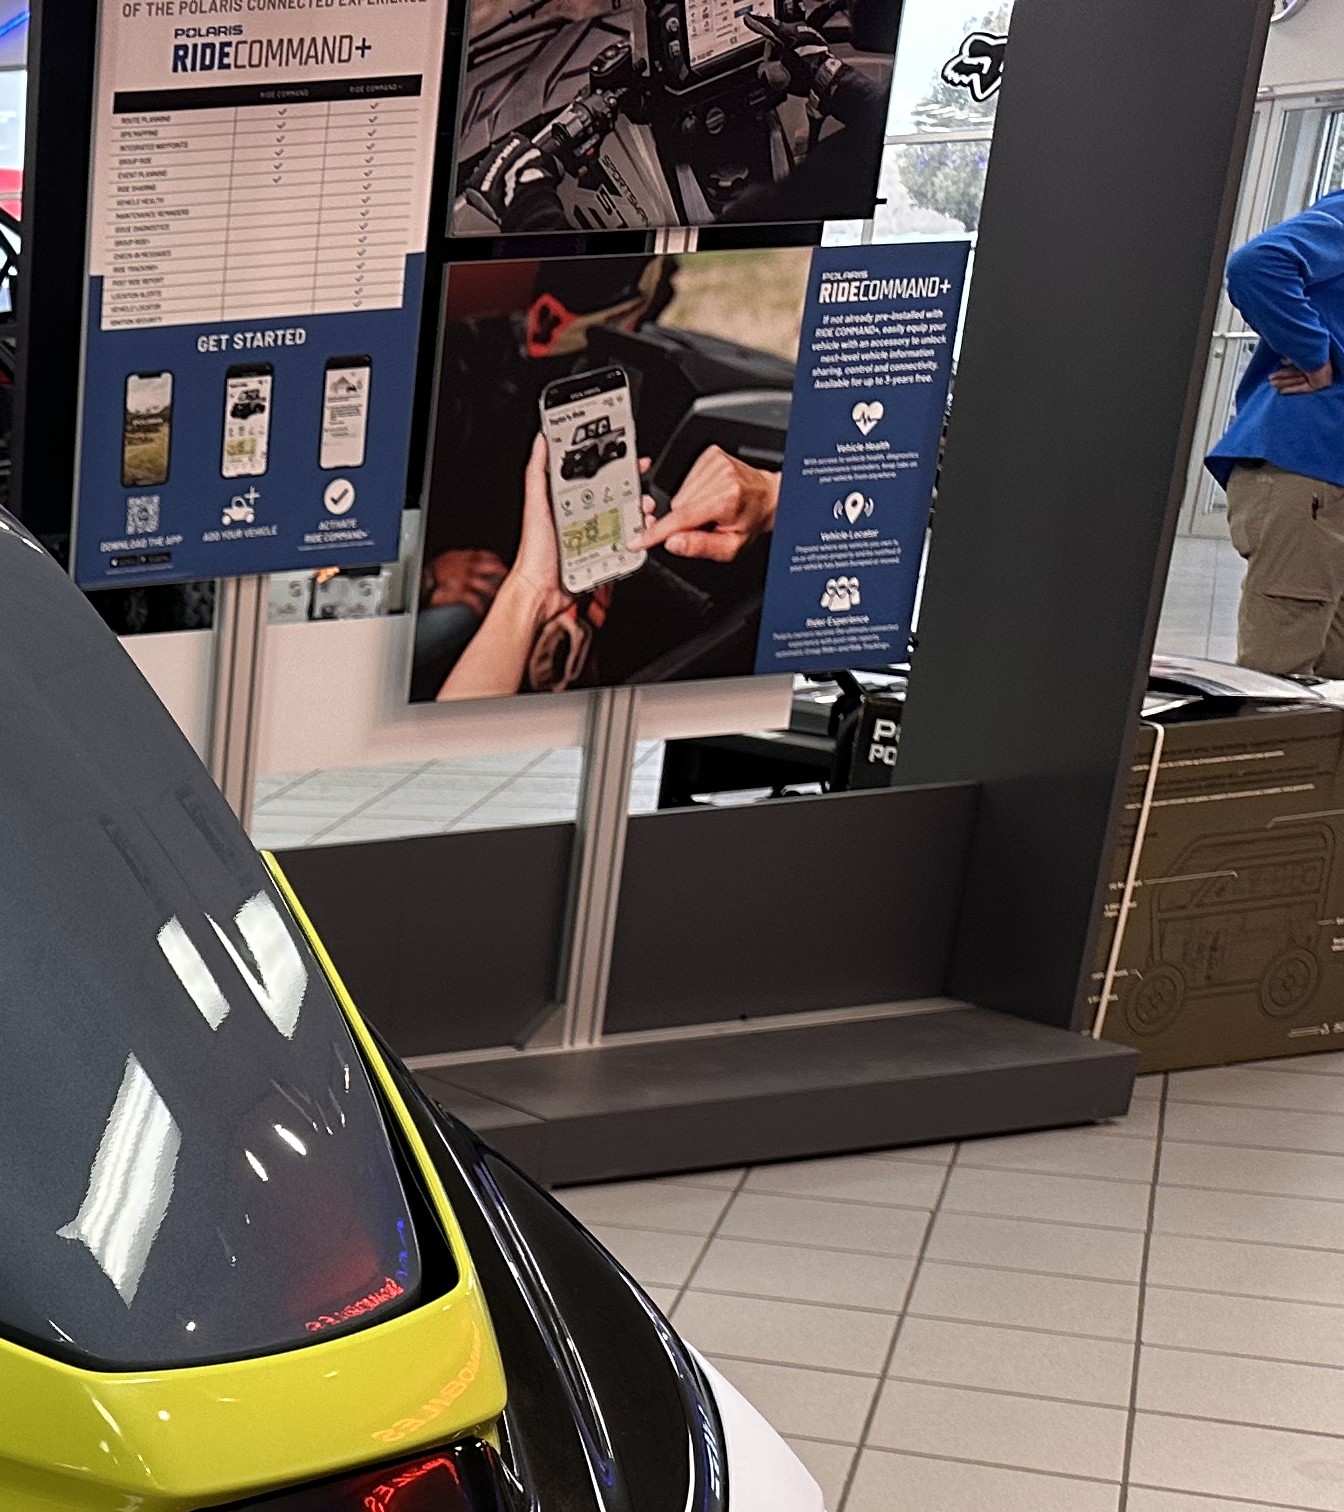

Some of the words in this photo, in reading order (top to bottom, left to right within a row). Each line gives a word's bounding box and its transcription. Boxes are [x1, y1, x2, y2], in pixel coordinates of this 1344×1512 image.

[123, 5, 138, 18] OF
[146, 2, 174, 17] THE
[179, 0, 242, 15] POLARIS
[174, 25, 243, 39] POLARIS
[172, 34, 372, 73] RIDECOMMAND+
[819, 276, 952, 304] RIDECOMMAND+
[197, 334, 229, 352] GET
[233, 328, 306, 349] STARTED
